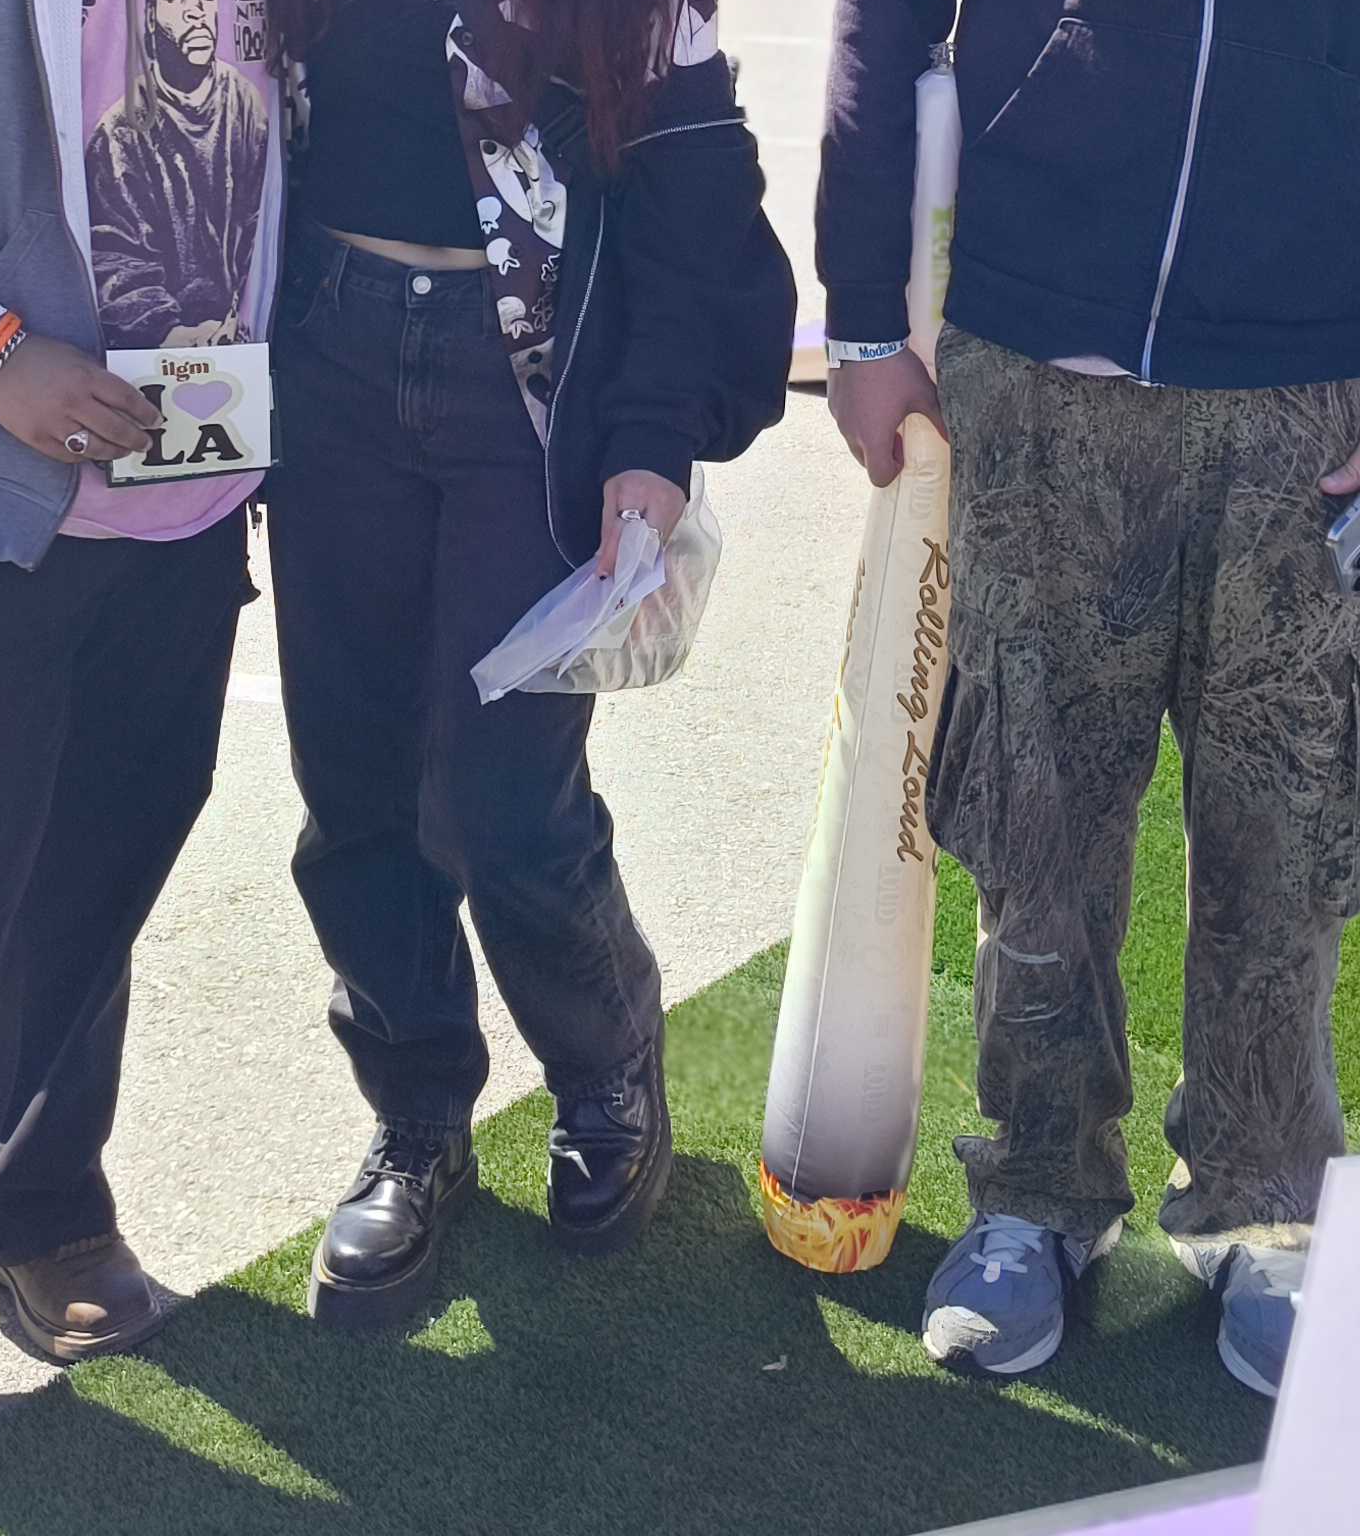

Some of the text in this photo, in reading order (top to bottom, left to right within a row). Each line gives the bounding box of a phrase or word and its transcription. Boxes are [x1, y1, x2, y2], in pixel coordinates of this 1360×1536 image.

[161, 359, 210, 382] ilgm
[140, 423, 244, 467] LA
[896, 537, 950, 723] Rolling
[896, 730, 930, 864] Loud
